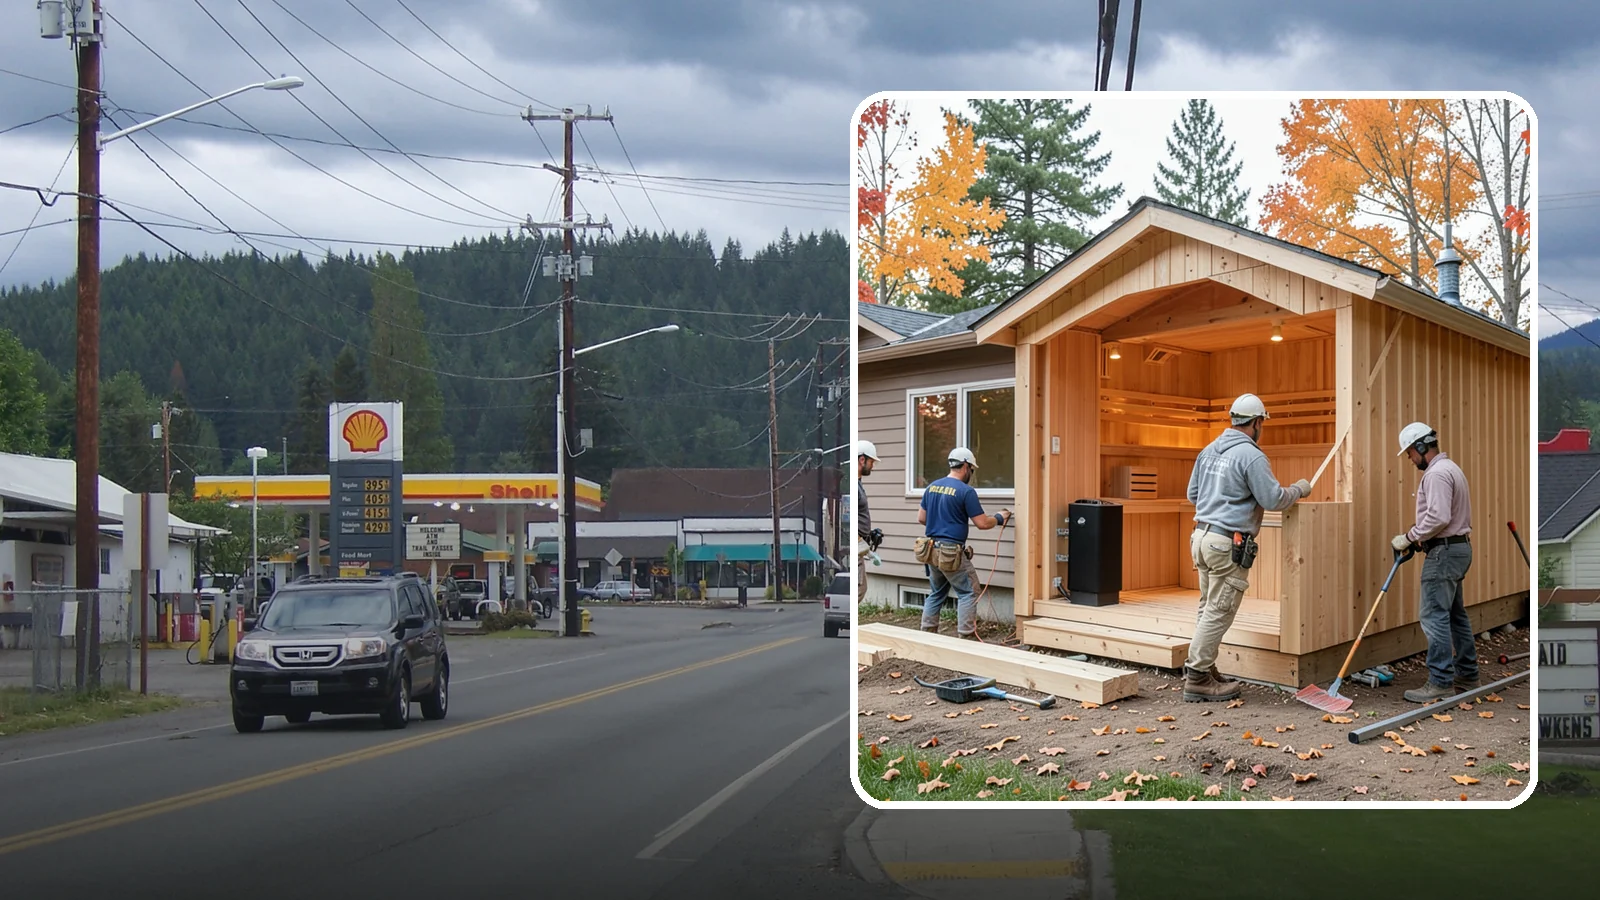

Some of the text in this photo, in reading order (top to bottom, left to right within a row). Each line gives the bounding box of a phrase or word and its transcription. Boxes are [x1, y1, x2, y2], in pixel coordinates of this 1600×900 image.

[366, 480, 383, 490] 395
[490, 484, 547, 499] Shell
[366, 494, 383, 504] 405
[366, 508, 383, 518] 415
[366, 522, 383, 532] 429
[1538, 643, 1567, 665] AID
